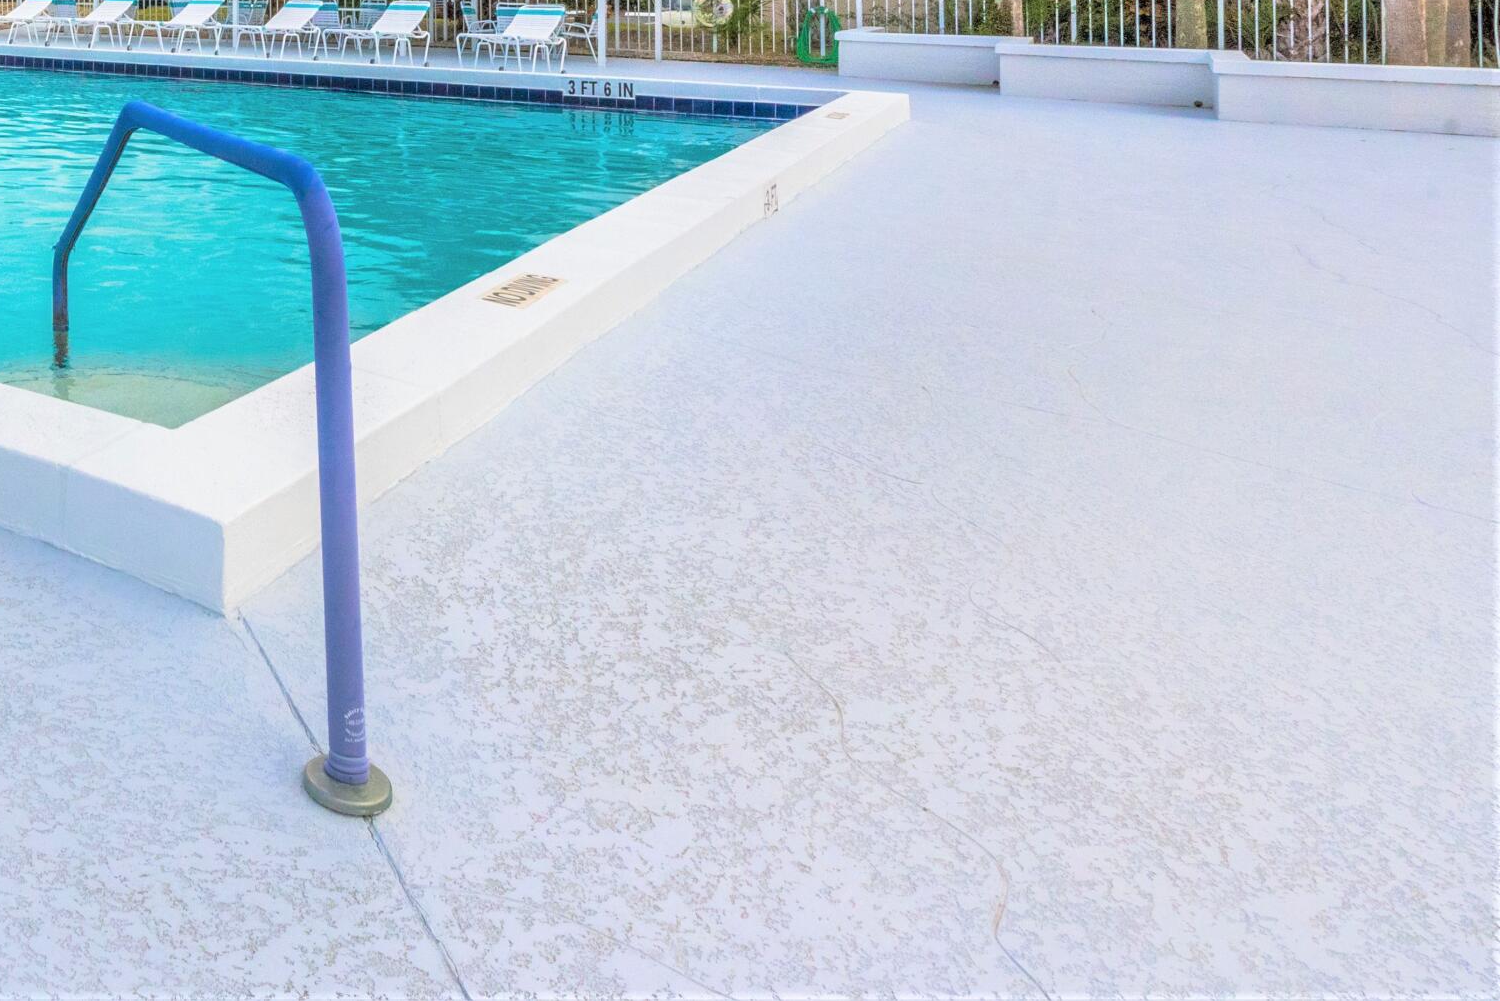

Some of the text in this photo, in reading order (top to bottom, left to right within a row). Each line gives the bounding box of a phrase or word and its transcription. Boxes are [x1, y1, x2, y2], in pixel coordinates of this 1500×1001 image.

[568, 80, 633, 98] 3 FT 6 IN
